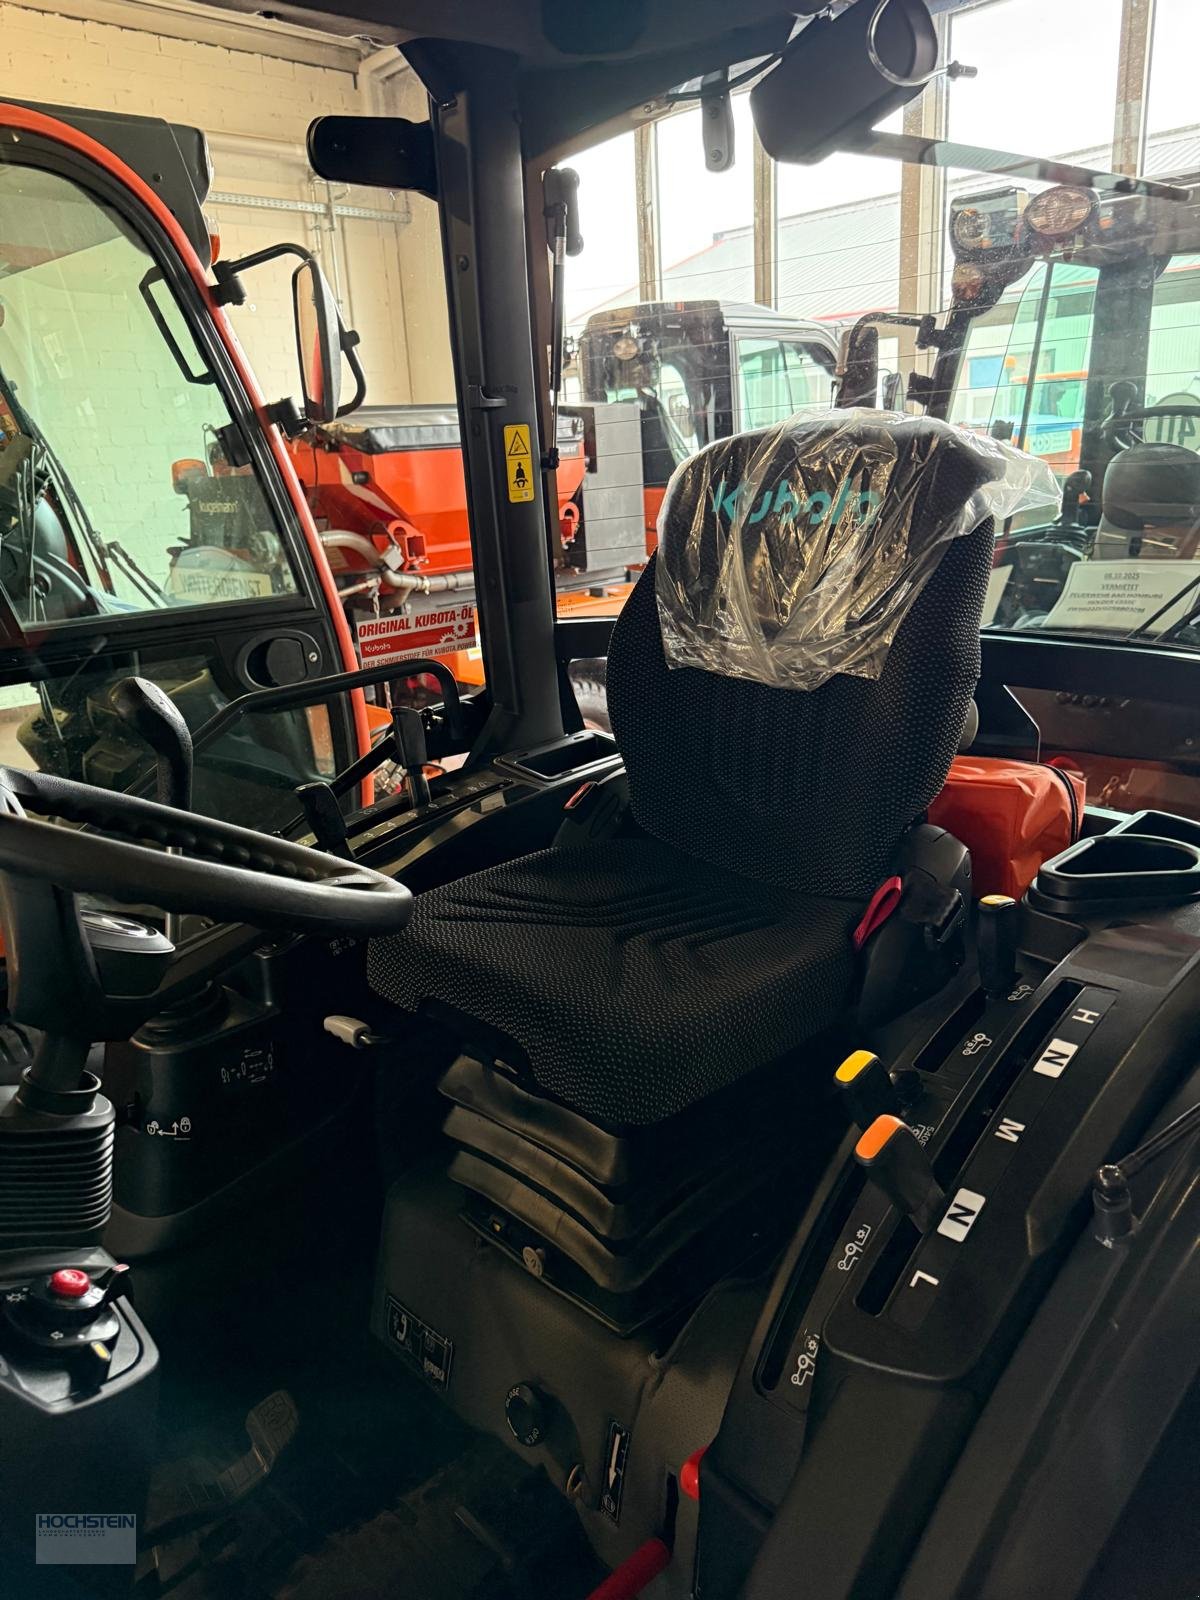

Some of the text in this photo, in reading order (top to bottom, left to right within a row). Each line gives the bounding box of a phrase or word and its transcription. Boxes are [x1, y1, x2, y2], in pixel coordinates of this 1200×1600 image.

[712, 478, 882, 524] Kubota
[358, 604, 474, 638] ORIGINAL KUBOTA-ÖL
[362, 640, 477, 668] DER SCHMIERSTOFF FÜR KUBOTA POWER
[364, 643, 391, 653] Kubota
[1072, 1007, 1101, 1025] H
[1042, 1049, 1070, 1068] N
[994, 1118, 1026, 1143] M
[947, 1203, 976, 1227] N
[909, 1270, 940, 1288] L
